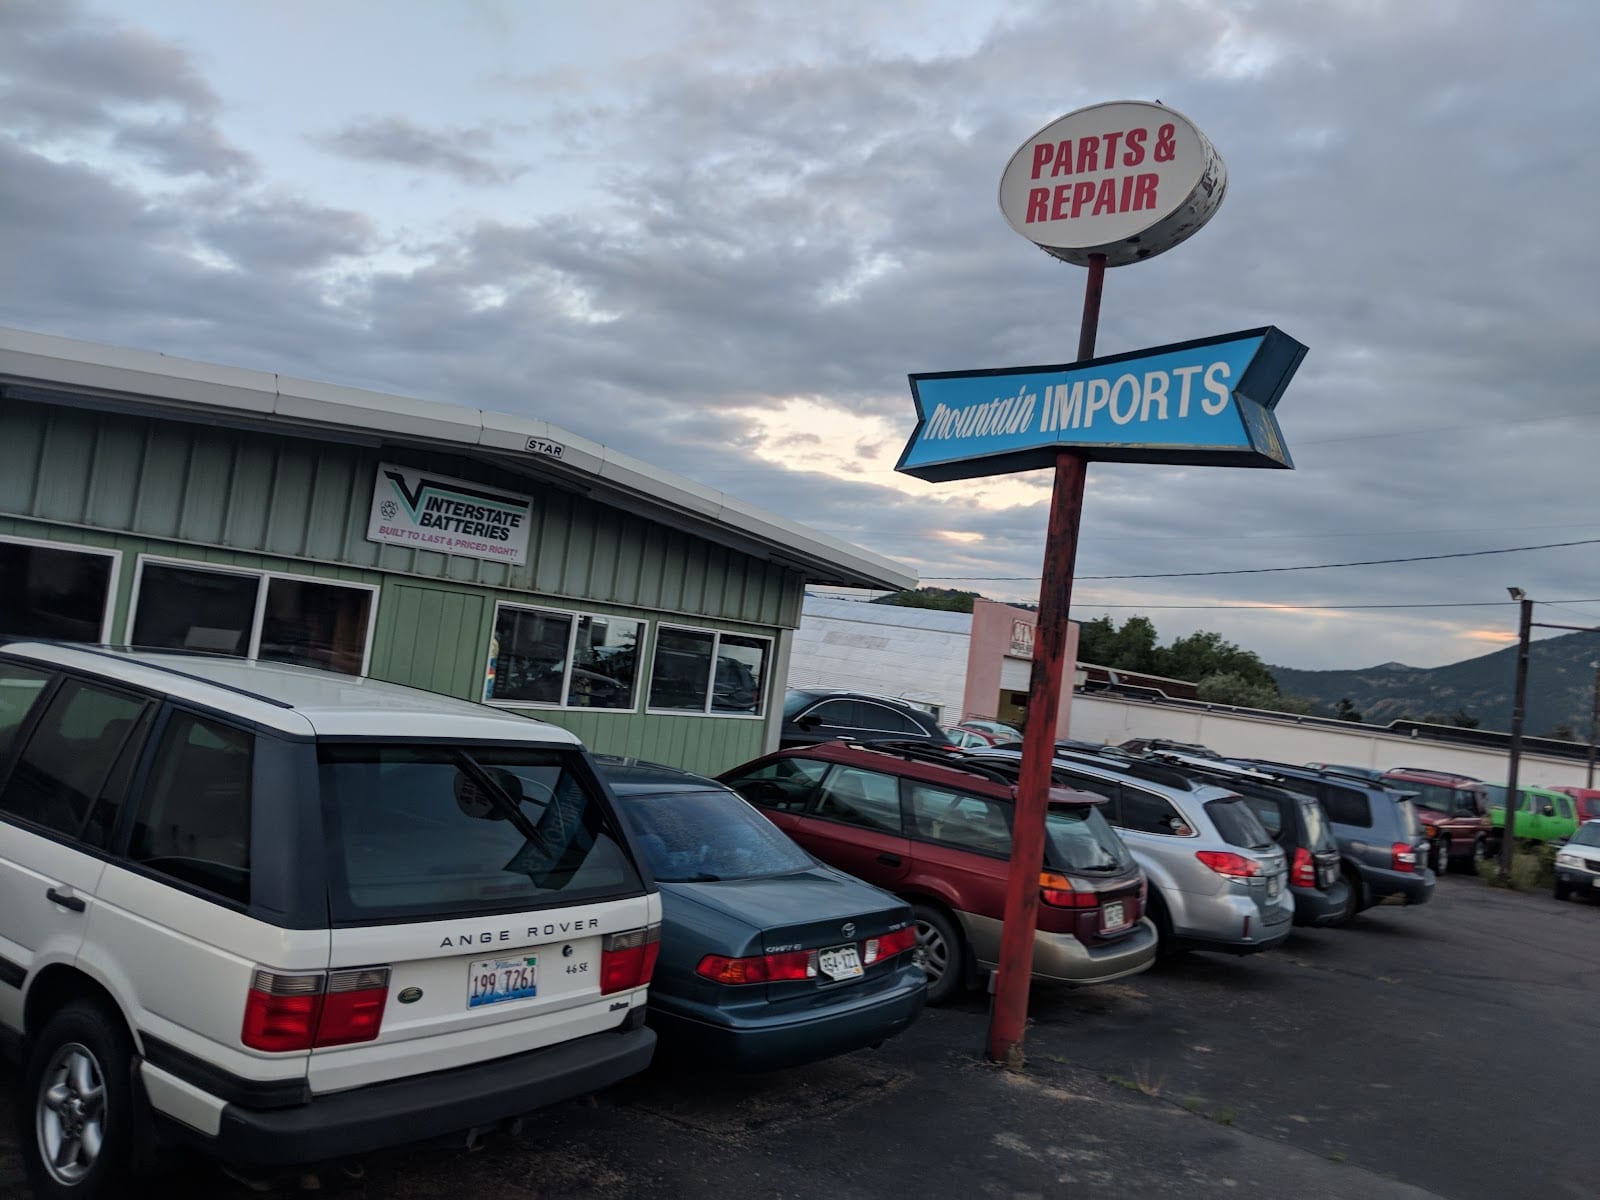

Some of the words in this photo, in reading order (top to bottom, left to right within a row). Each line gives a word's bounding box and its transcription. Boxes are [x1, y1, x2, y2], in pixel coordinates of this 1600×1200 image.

[1031, 128, 1148, 180] PARTS
[1154, 123, 1177, 163] &
[1025, 173, 1160, 224] REPAIR
[1040, 361, 1231, 433] IMPORTS
[528, 440, 562, 456] STAR
[419, 512, 510, 541] BATTERIES
[425, 496, 522, 528] INTERSTATE
[379, 526, 405, 538] BUILT
[408, 531, 420, 540] TO
[421, 533, 447, 545] LAST
[455, 539, 488, 552] PRICED
[488, 544, 518, 557] RIGHT!
[440, 930, 510, 948] ANGE
[527, 918, 599, 938] ROVER
[474, 972, 497, 998] 199
[505, 967, 536, 992] 7261
